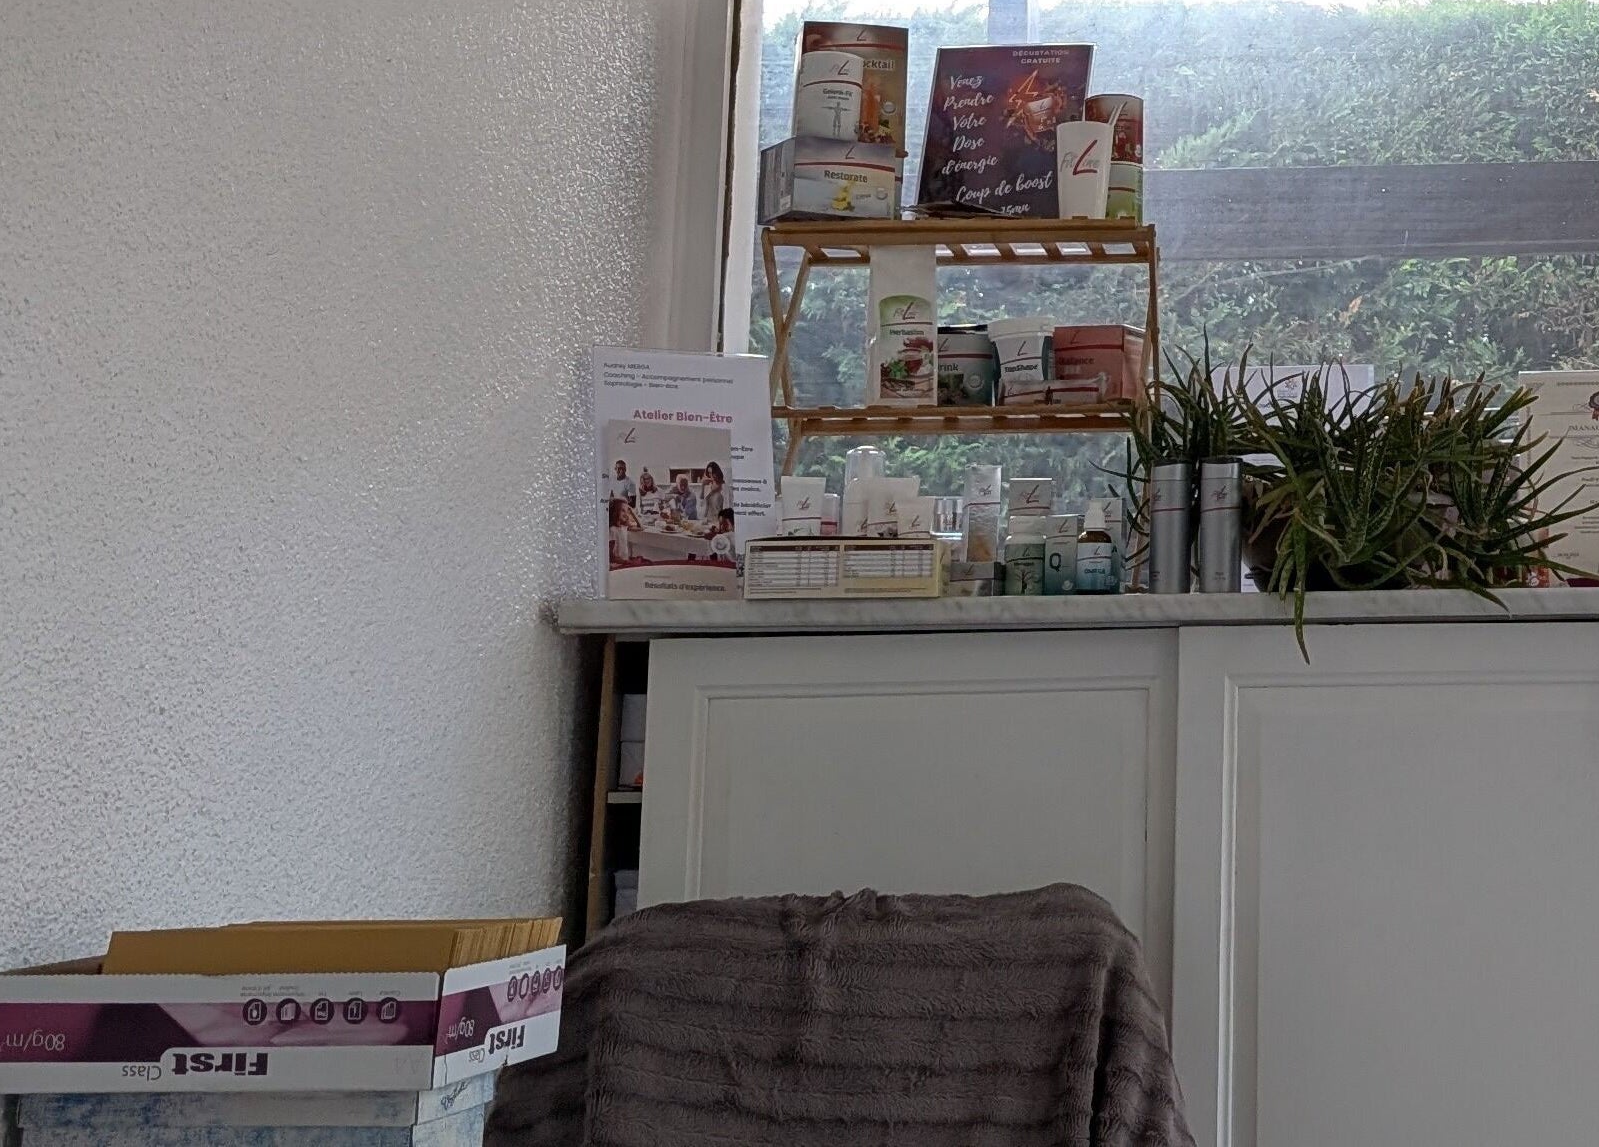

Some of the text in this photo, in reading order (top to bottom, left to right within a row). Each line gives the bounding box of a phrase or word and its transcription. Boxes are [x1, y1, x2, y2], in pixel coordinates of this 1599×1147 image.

[862, 59, 895, 69] ocktail
[950, 75, 984, 90] Venez
[943, 92, 995, 111] Prendre
[952, 112, 987, 130] Votre
[952, 135, 984, 152] Dose
[941, 155, 999, 175] d'énergie
[823, 169, 868, 183] Restorate
[956, 171, 1054, 204] Coup de boost
[938, 363, 959, 372] rink
[633, 409, 734, 423] Atelier Bien-Être
[488, 1025, 526, 1055] First
[172, 1052, 269, 1077] First
[122, 1065, 162, 1082] Class
